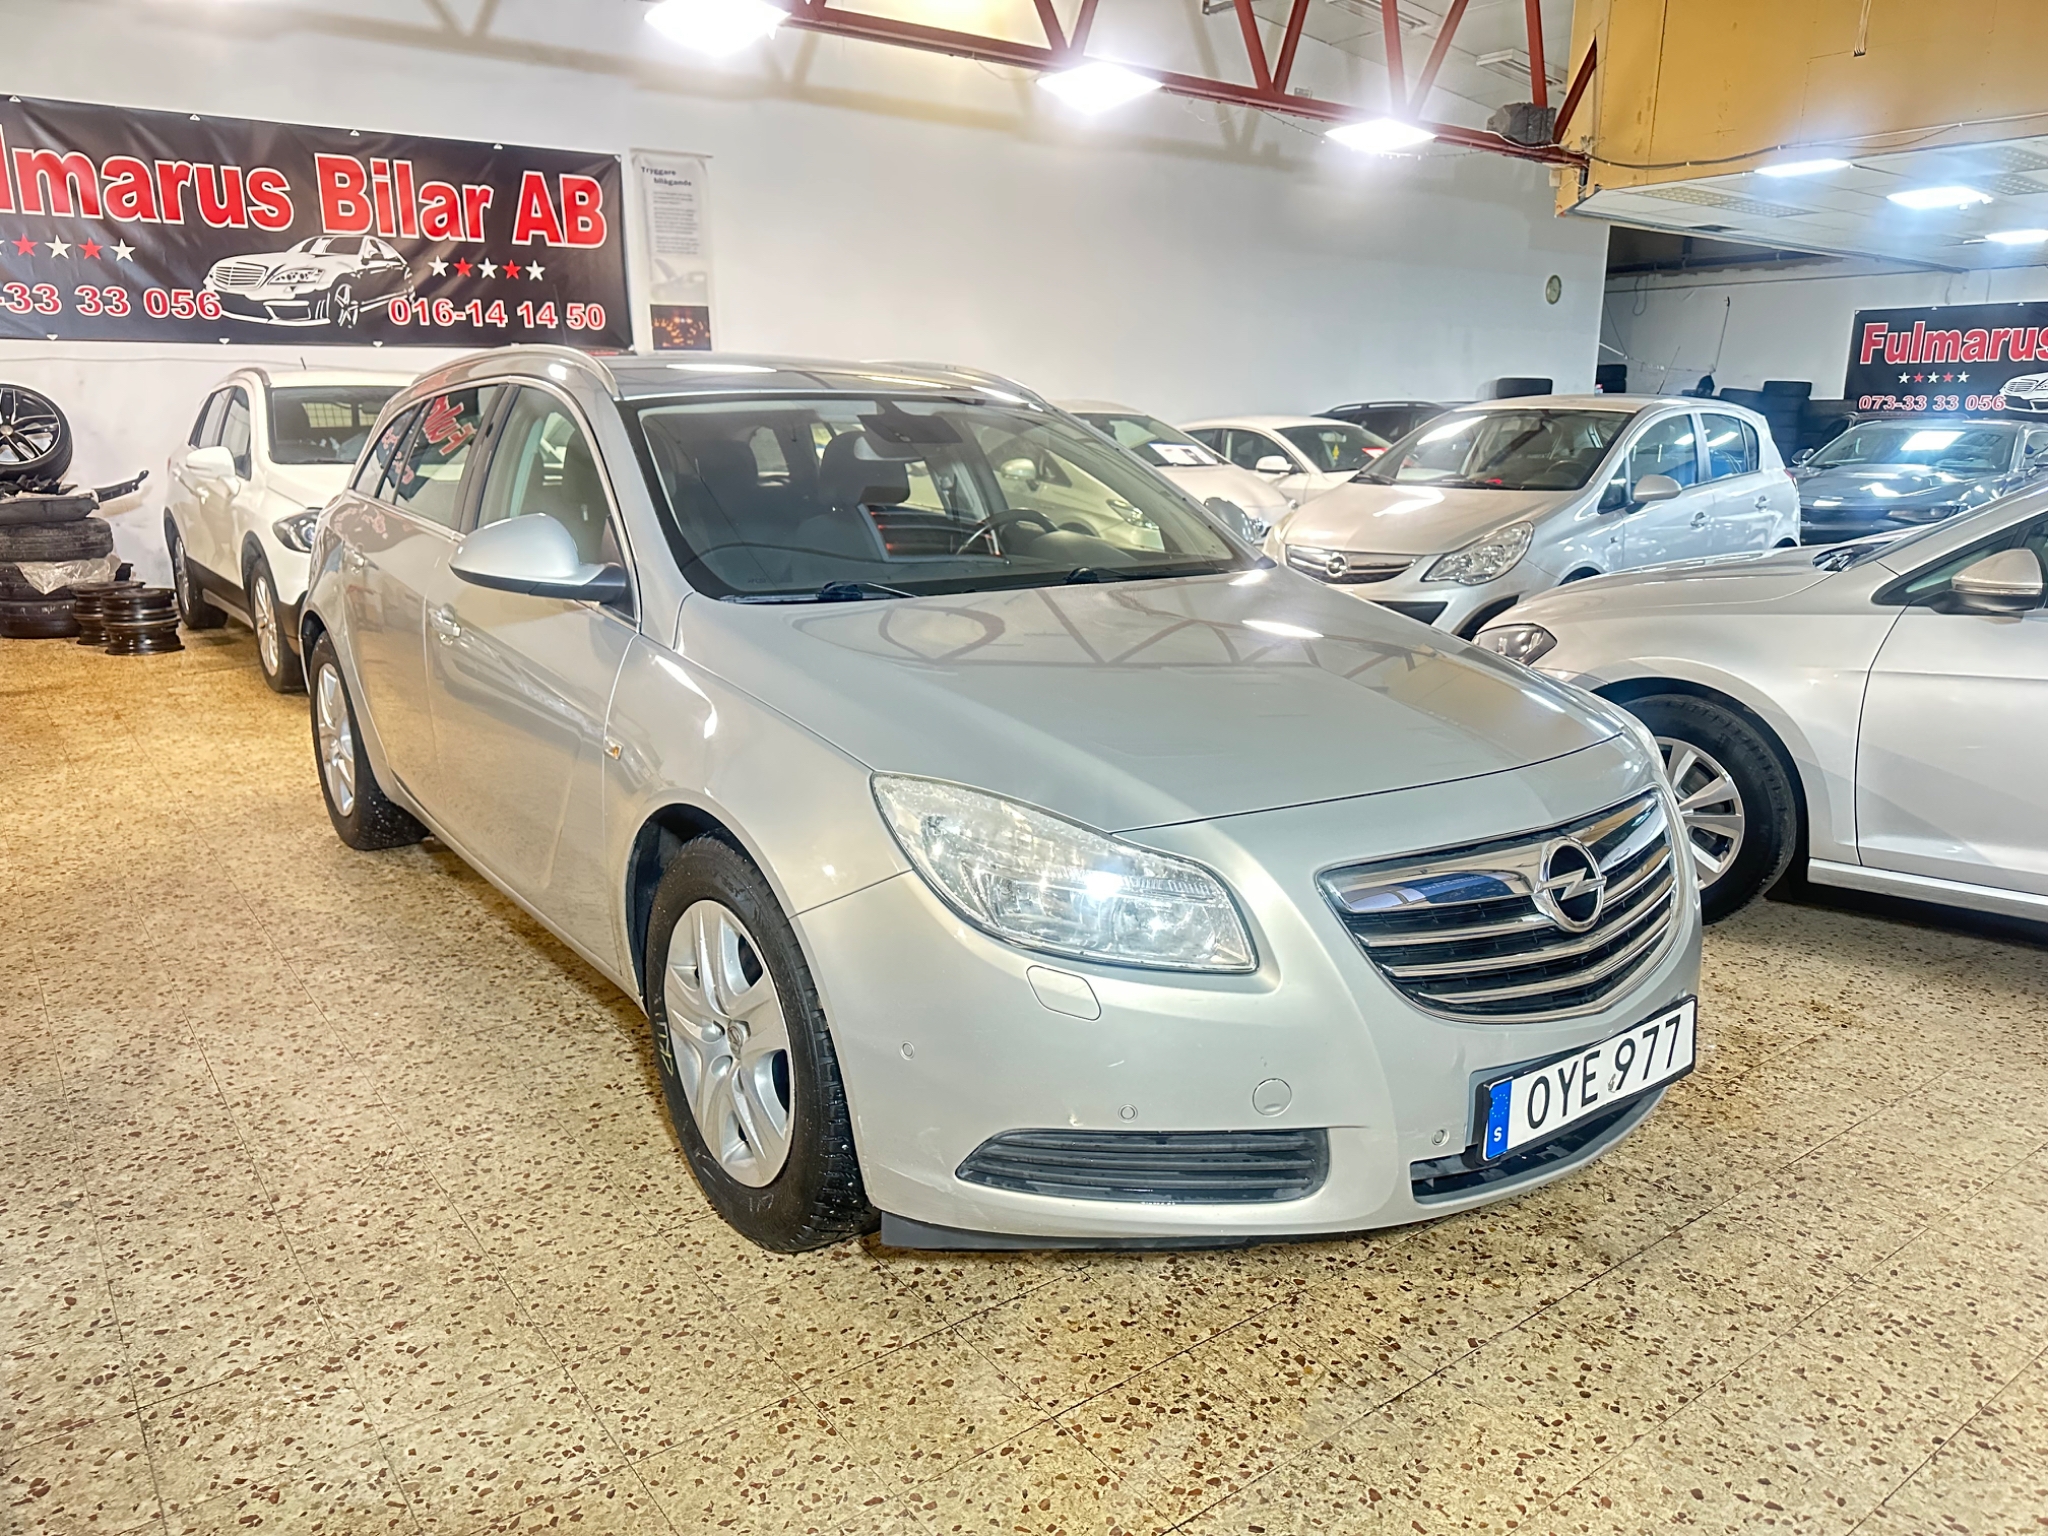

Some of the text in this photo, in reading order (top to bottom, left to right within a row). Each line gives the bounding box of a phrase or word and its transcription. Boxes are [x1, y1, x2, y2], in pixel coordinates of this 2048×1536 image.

[314, 152, 494, 243] Bilar
[511, 170, 607, 249] AB
[74, 285, 131, 317] 33
[143, 288, 223, 320] 056
[388, 296, 606, 331] 016-14 14 50
[1858, 394, 2007, 411] 073-33 33 056
[1526, 1013, 1682, 1130] OYE 977
[1493, 1126, 1503, 1143] S
